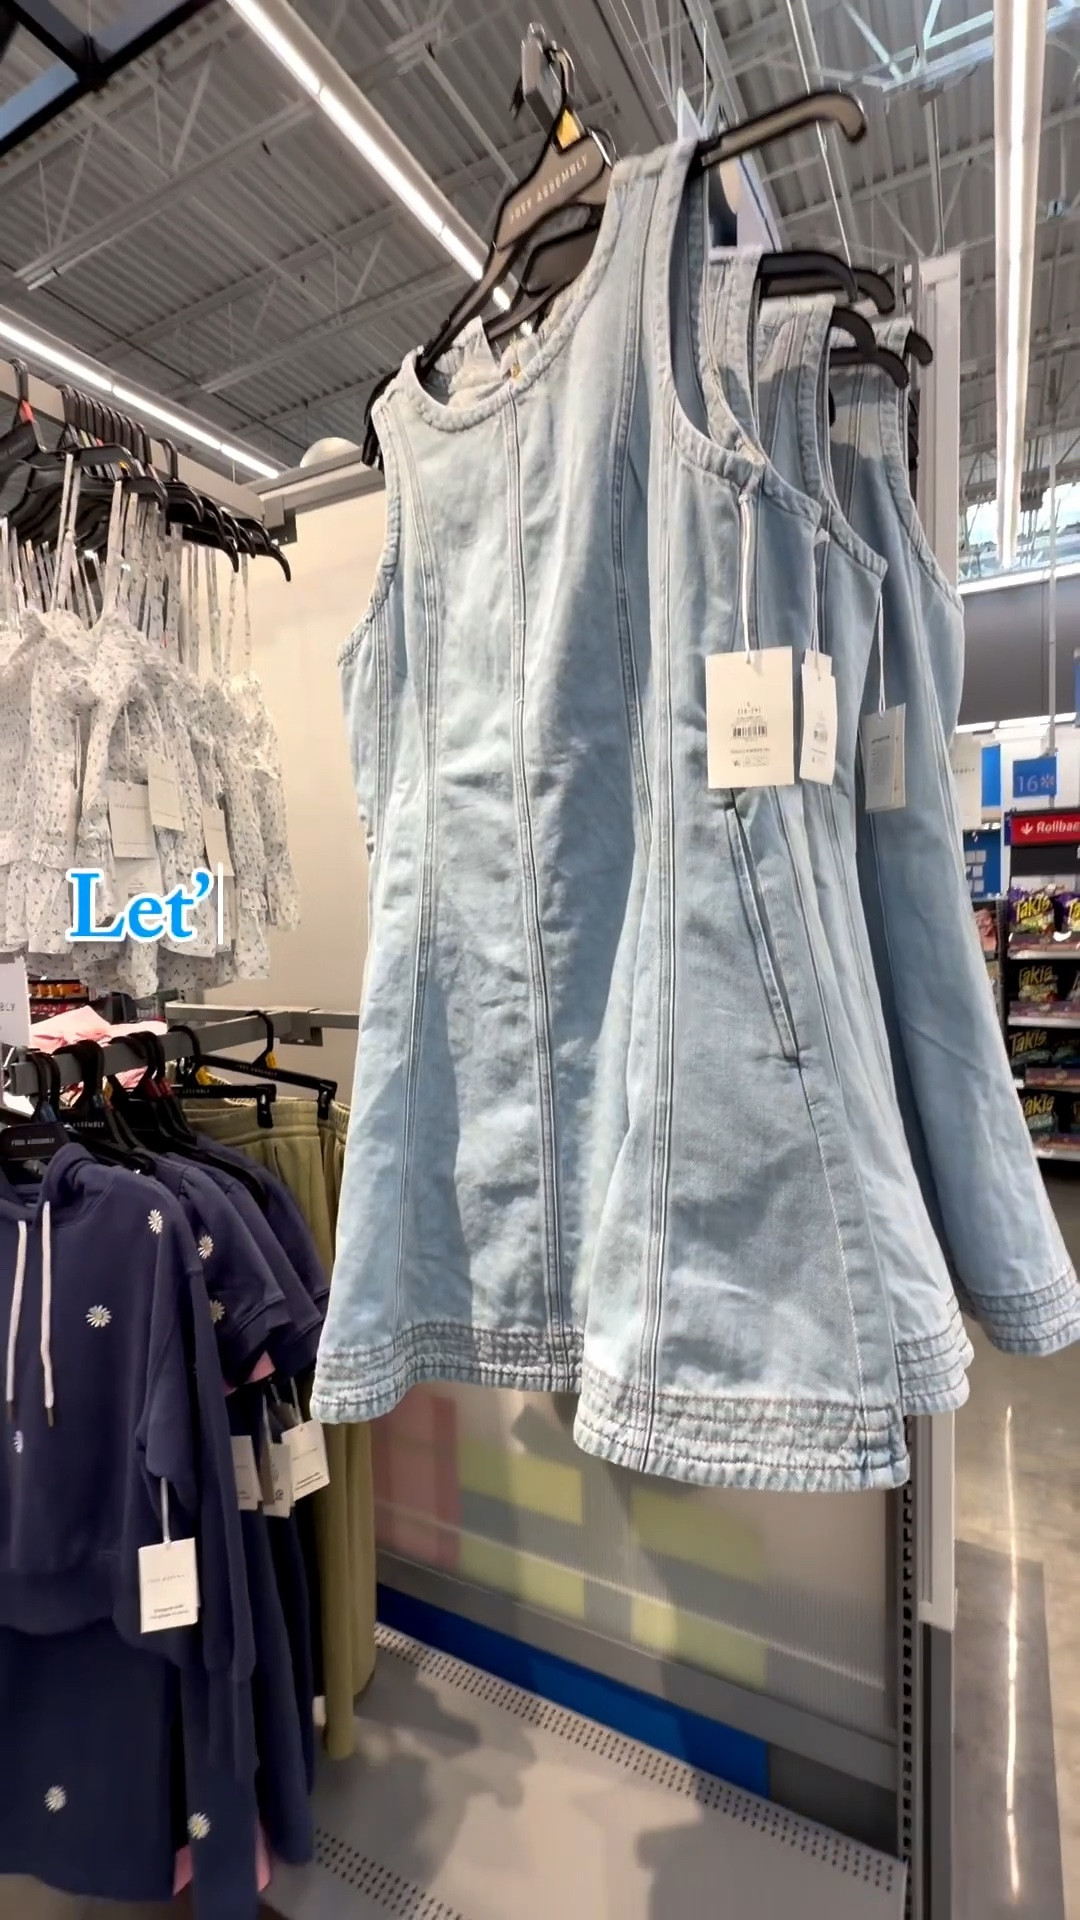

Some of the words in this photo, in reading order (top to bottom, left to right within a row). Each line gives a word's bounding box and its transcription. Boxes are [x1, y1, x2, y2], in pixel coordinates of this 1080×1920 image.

[1018, 774, 1039, 793] 16
[1013, 892, 1051, 923] Takis
[1009, 1030, 1047, 1056] Takis
[1023, 1094, 1055, 1116] akis
